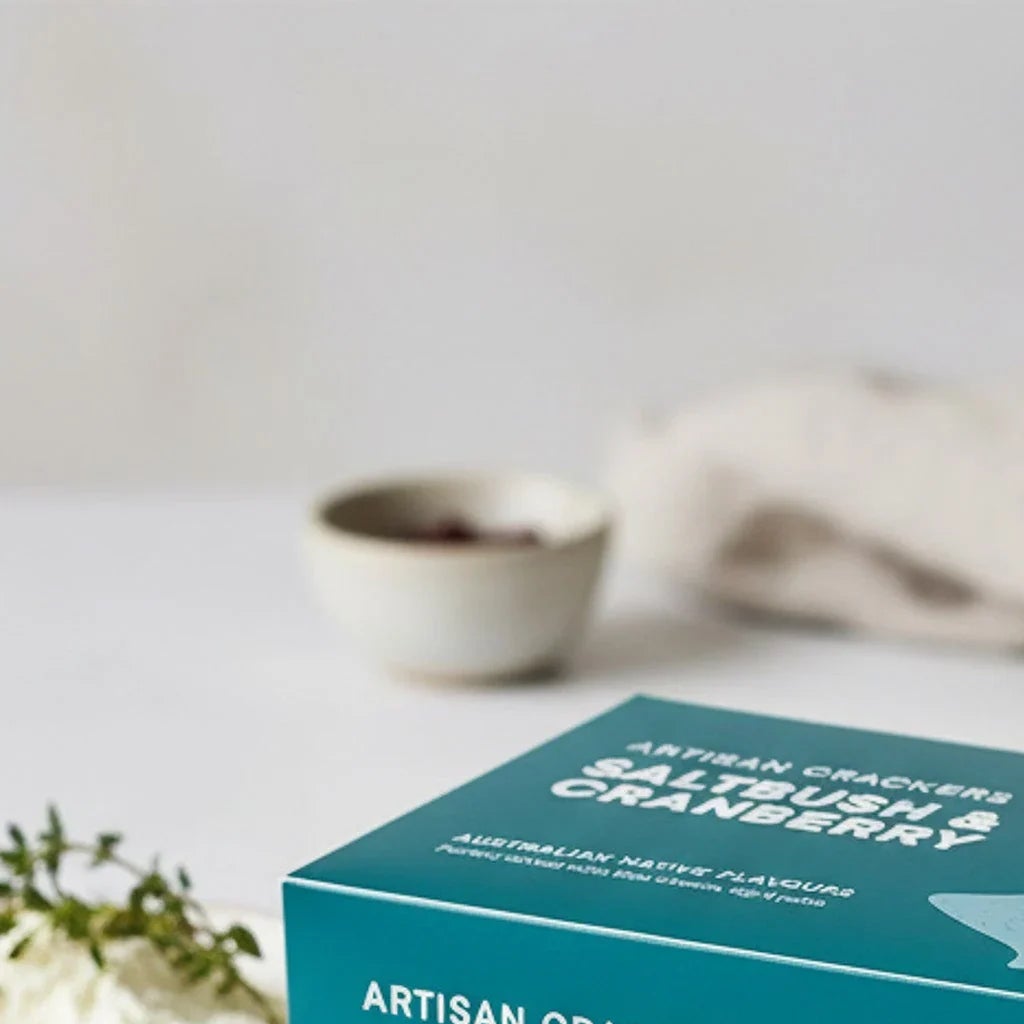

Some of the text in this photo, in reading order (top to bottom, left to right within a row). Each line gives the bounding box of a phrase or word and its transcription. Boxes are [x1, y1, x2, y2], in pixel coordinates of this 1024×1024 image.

[550, 778, 986, 851] CRANBERRY
[582, 757, 1000, 832] SALTBUSH &
[802, 765, 1013, 805] CRACKERS
